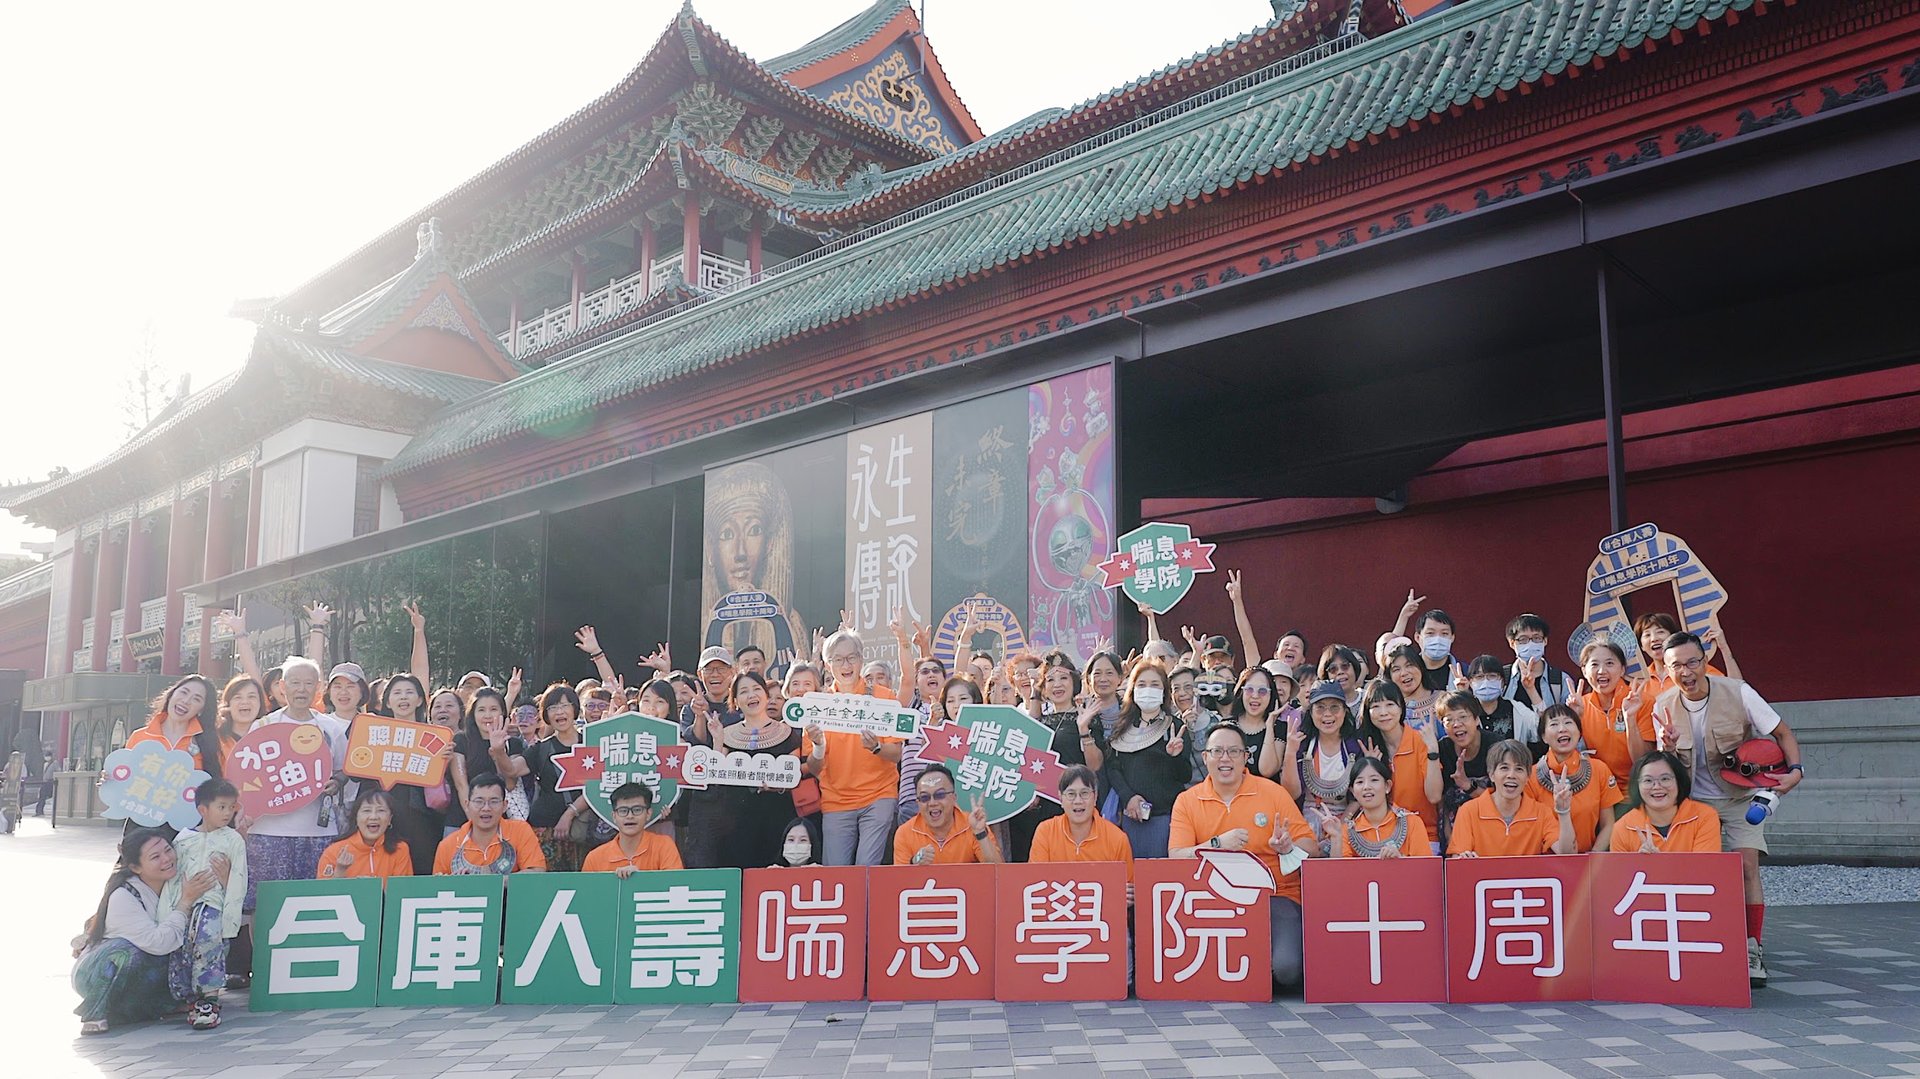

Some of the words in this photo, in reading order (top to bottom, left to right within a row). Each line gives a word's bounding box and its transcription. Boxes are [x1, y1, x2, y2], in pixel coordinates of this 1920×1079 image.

[1131, 536, 1178, 565] 喘息
[1134, 563, 1181, 593] 學院
[368, 725, 416, 748] 聰明
[599, 731, 661, 766] 喘息
[966, 721, 1029, 766] 喘息
[381, 751, 431, 776] 照顧
[956, 755, 1022, 803] 學院
